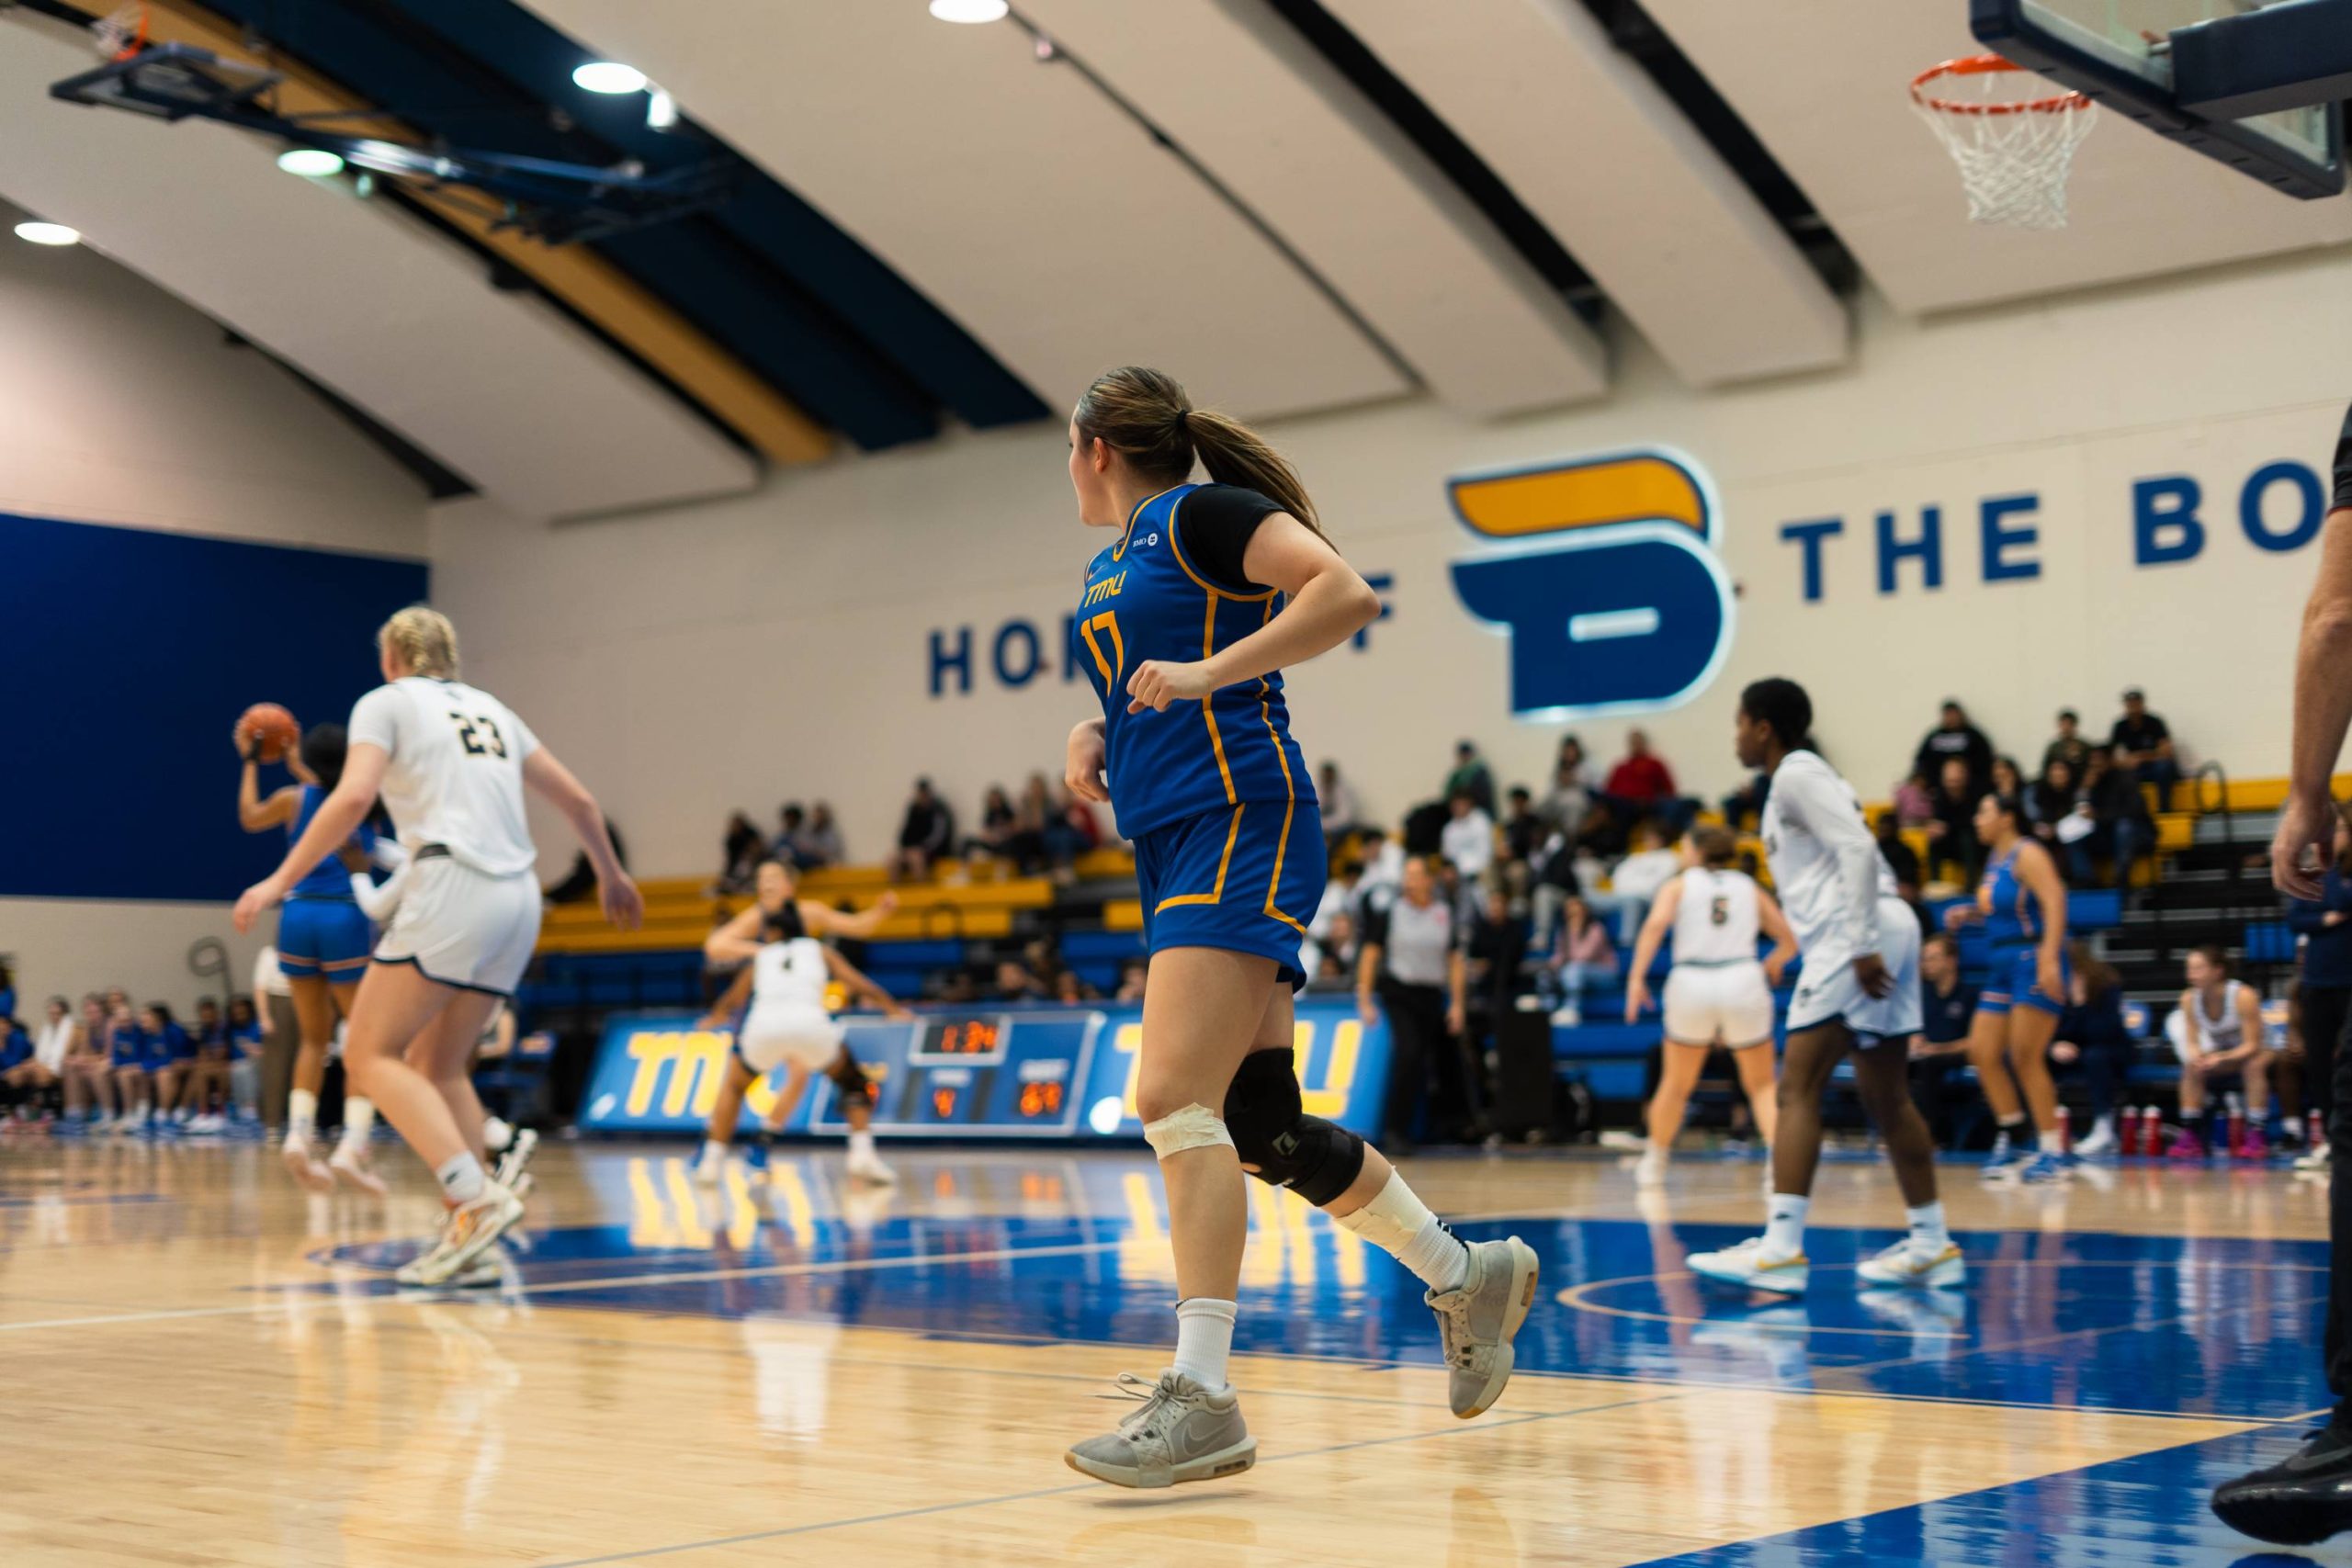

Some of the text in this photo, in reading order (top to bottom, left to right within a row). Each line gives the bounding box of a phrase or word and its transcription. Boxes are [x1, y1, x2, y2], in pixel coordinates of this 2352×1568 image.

[1779, 491, 2042, 605] THE
[2132, 458, 2327, 568] BO
[1084, 570, 1127, 609] TMU
[1080, 610, 1124, 698] 17
[448, 711, 508, 759] 23
